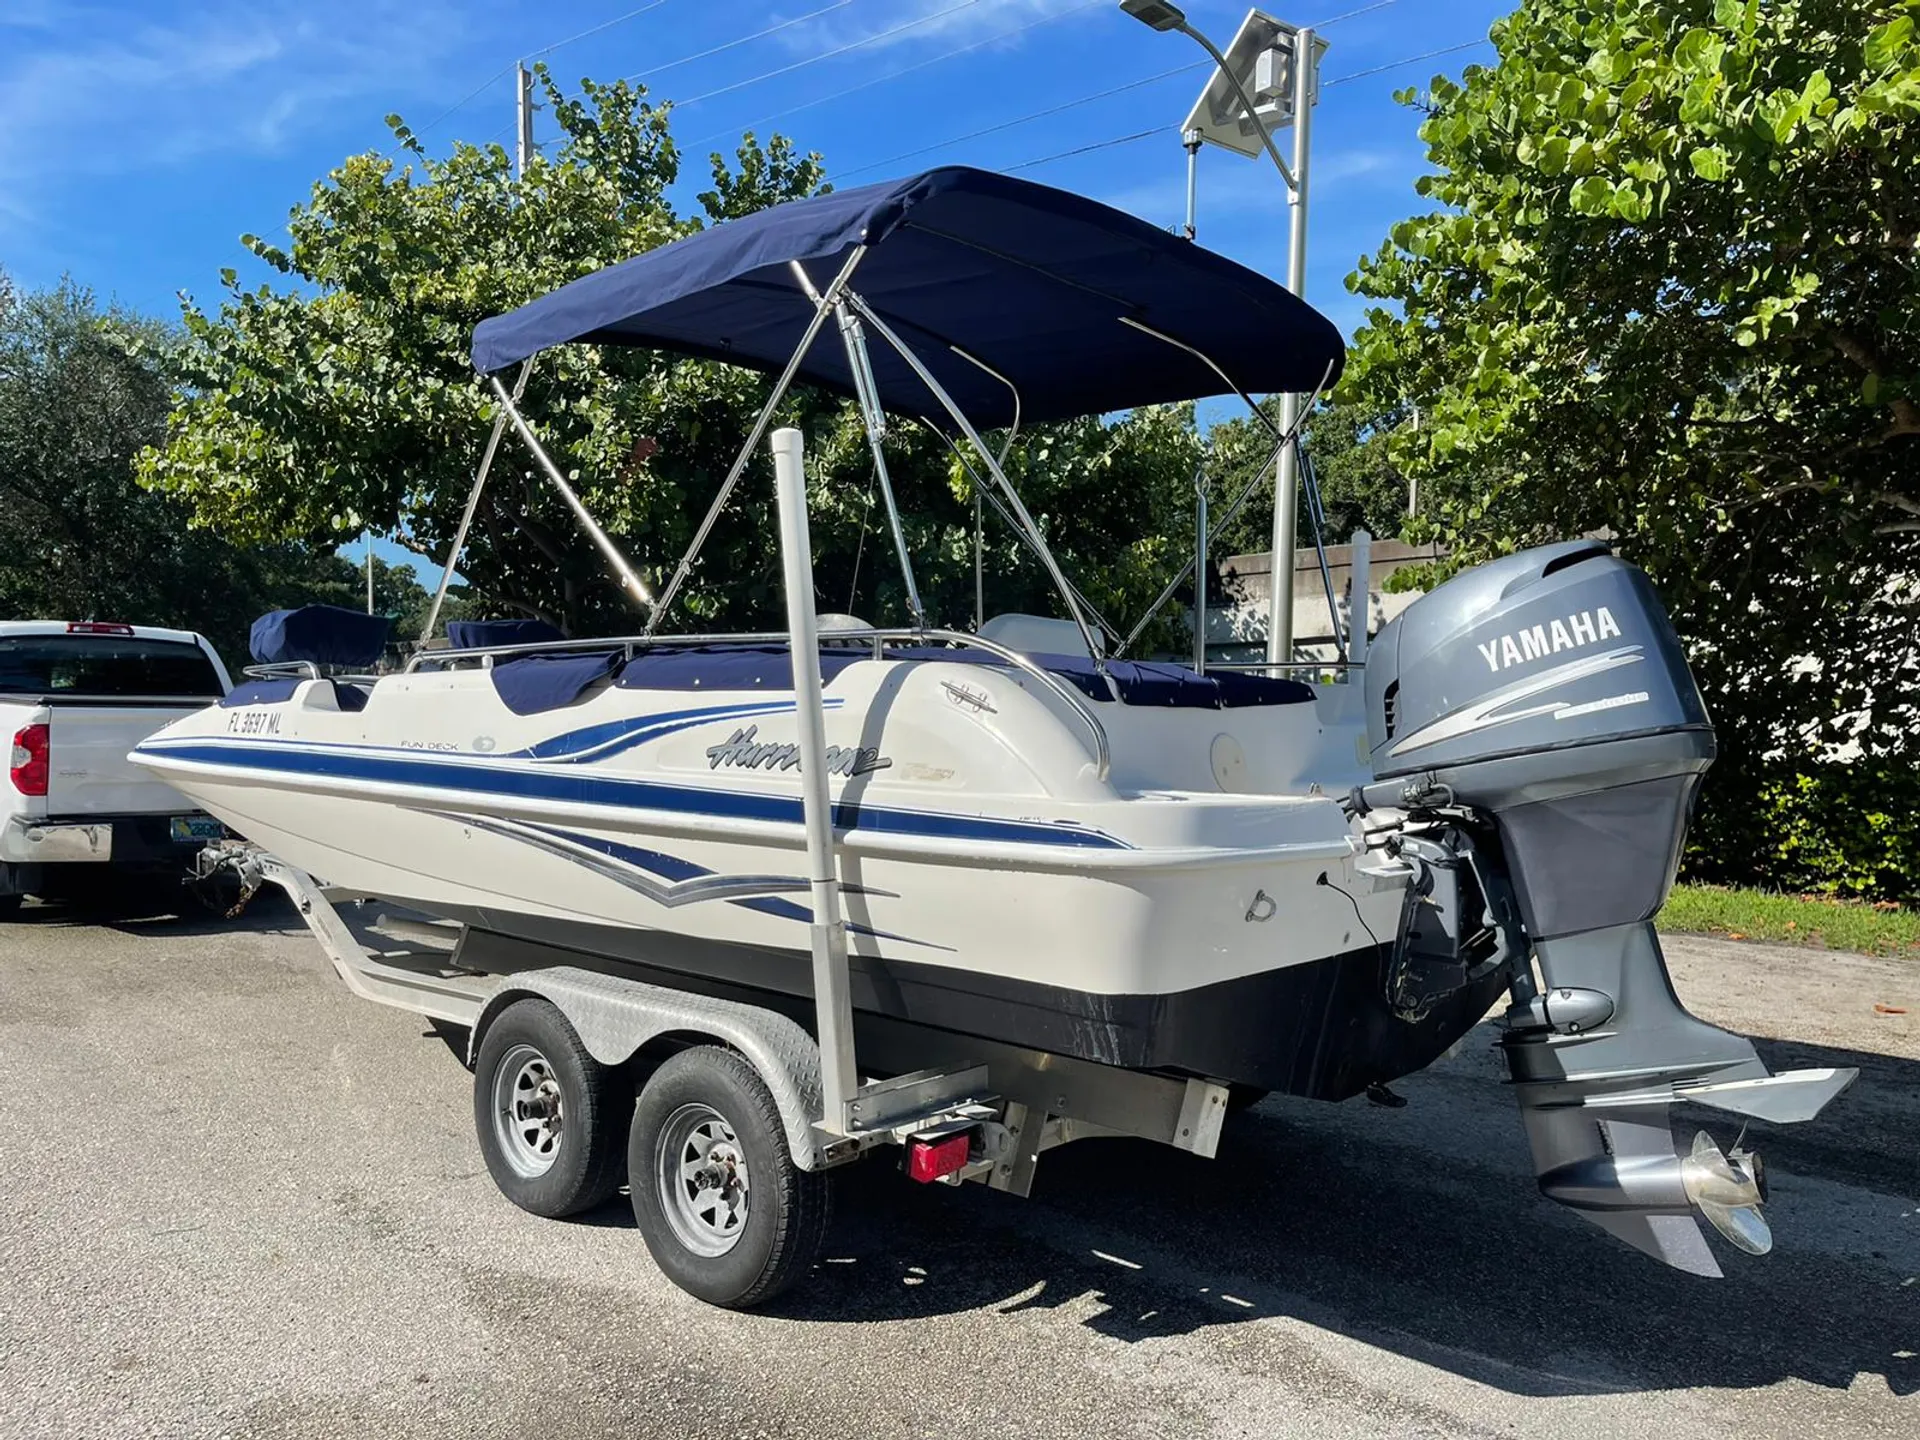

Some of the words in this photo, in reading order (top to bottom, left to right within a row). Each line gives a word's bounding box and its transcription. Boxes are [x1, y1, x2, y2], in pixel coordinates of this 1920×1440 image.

[1477, 606, 1622, 673] YAMAHA
[227, 712, 241, 733] FL
[266, 712, 281, 734] ML
[400, 740, 424, 749] FUN
[428, 742, 459, 751] DECK
[706, 724, 893, 777] Hurriane
